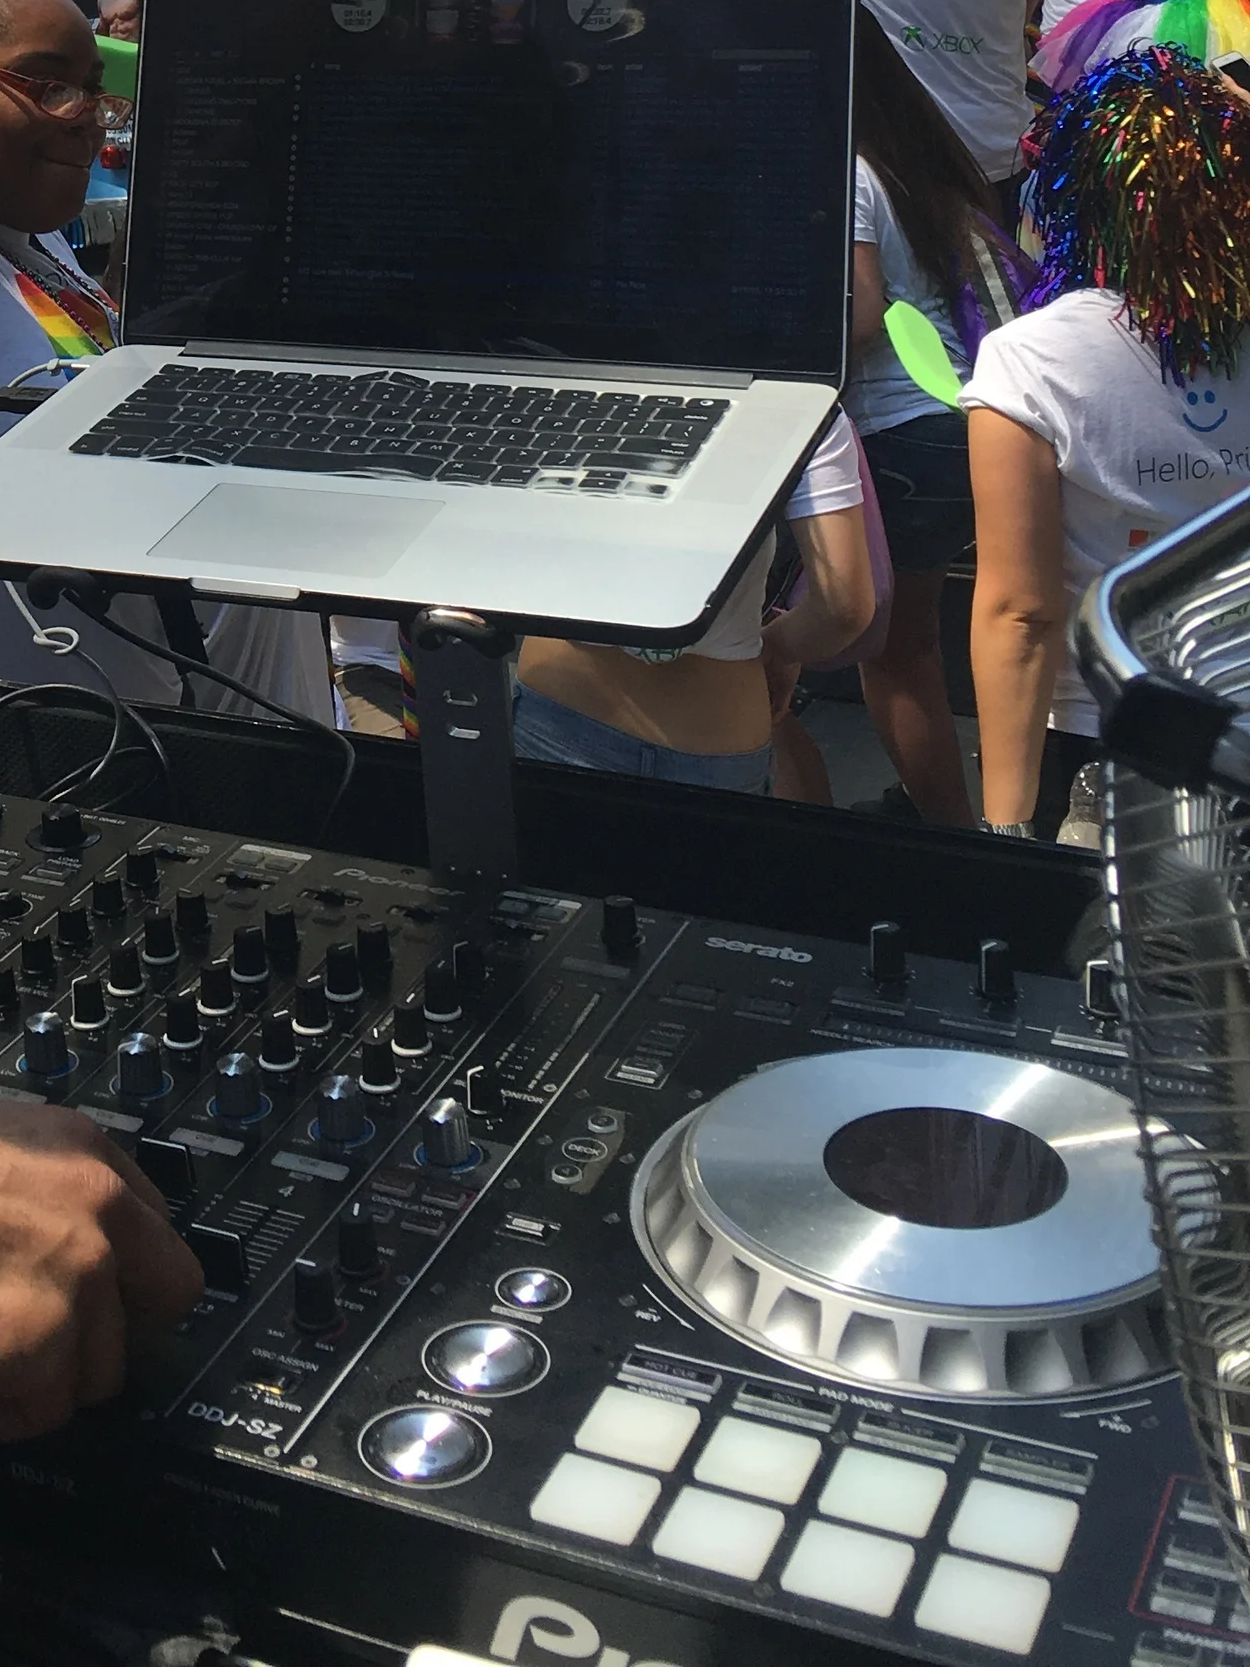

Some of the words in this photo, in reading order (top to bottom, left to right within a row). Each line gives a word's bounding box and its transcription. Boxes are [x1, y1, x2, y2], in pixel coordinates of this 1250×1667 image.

[933, 33, 984, 54] XBOX
[1136, 452, 1215, 487] Hello,
[705, 936, 813, 964] serato
[567, 1142, 602, 1157] DECK
[188, 1402, 283, 1440] DDJ-SZ
